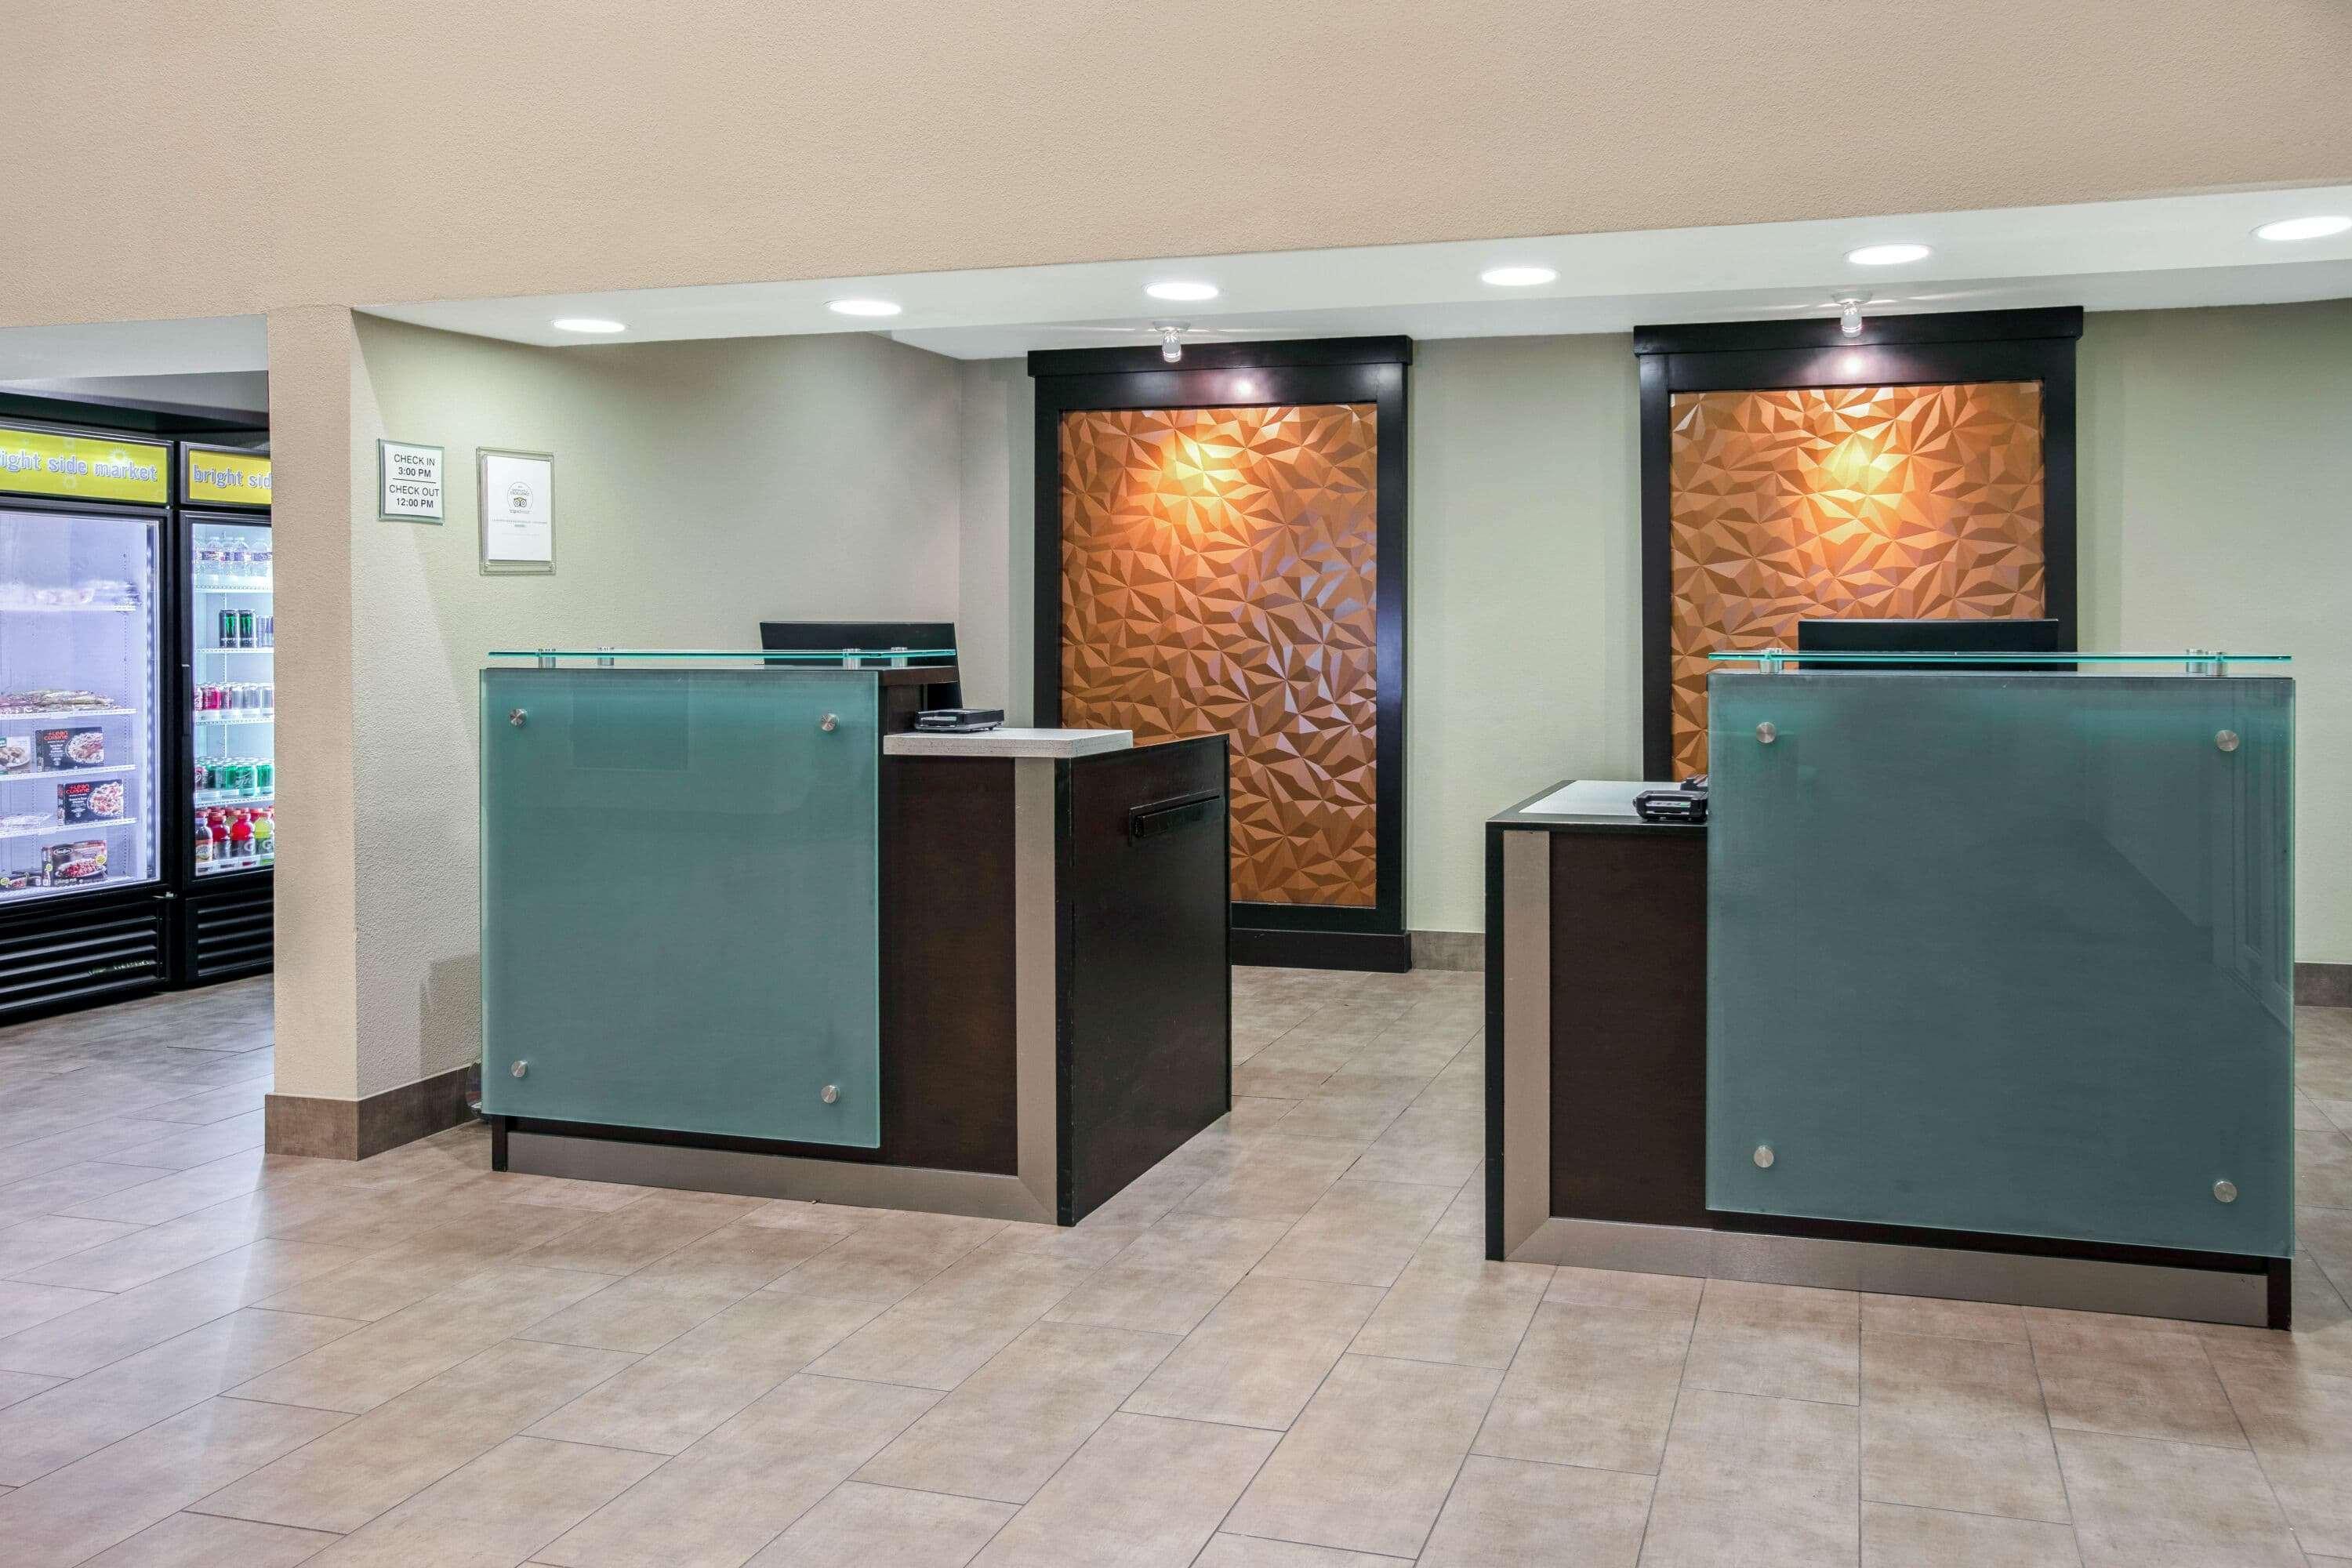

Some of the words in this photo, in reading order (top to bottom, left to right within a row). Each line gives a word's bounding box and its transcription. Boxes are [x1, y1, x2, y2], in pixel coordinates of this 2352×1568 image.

[0, 449, 41, 471] ight
[48, 456, 88, 475] side
[94, 461, 158, 481] market
[394, 454, 424, 465] CHECK
[426, 458, 435, 466] IN
[193, 464, 243, 488] bright
[248, 472, 272, 489] sid
[398, 466, 416, 477] 3:00
[418, 468, 431, 477] PM
[389, 485, 420, 495] CHECK
[422, 487, 440, 497] OUT
[397, 498, 419, 507] 12:00
[421, 499, 434, 508] PM
